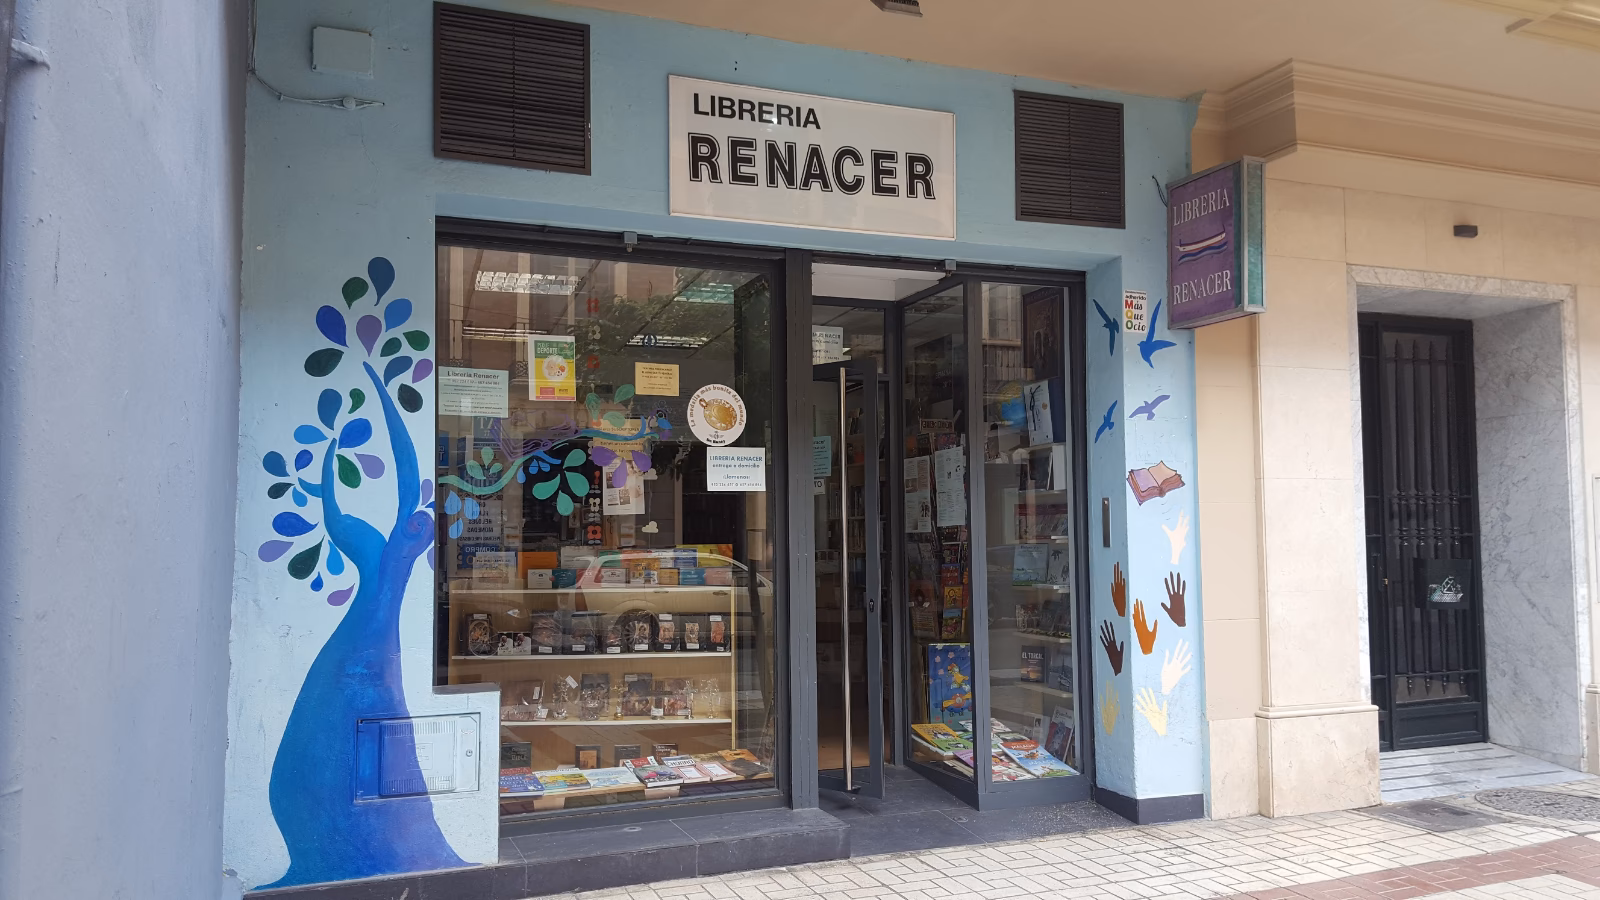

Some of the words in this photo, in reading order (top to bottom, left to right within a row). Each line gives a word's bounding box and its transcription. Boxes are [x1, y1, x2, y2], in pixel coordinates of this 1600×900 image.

[693, 92, 821, 130] LIBRERIA
[687, 132, 936, 200] RENACER
[1173, 187, 1230, 226] LIBRERIA
[1125, 299, 1143, 310] Más
[1173, 269, 1232, 305] RENACER
[1125, 309, 1144, 320] Que
[1125, 320, 1146, 331] Ocio
[473, 372, 500, 380] Renacer
[689, 394, 701, 418] medalla
[700, 386, 712, 395] más
[712, 385, 732, 395] bonita
[731, 394, 741, 403] del
[737, 404, 745, 426] mundo
